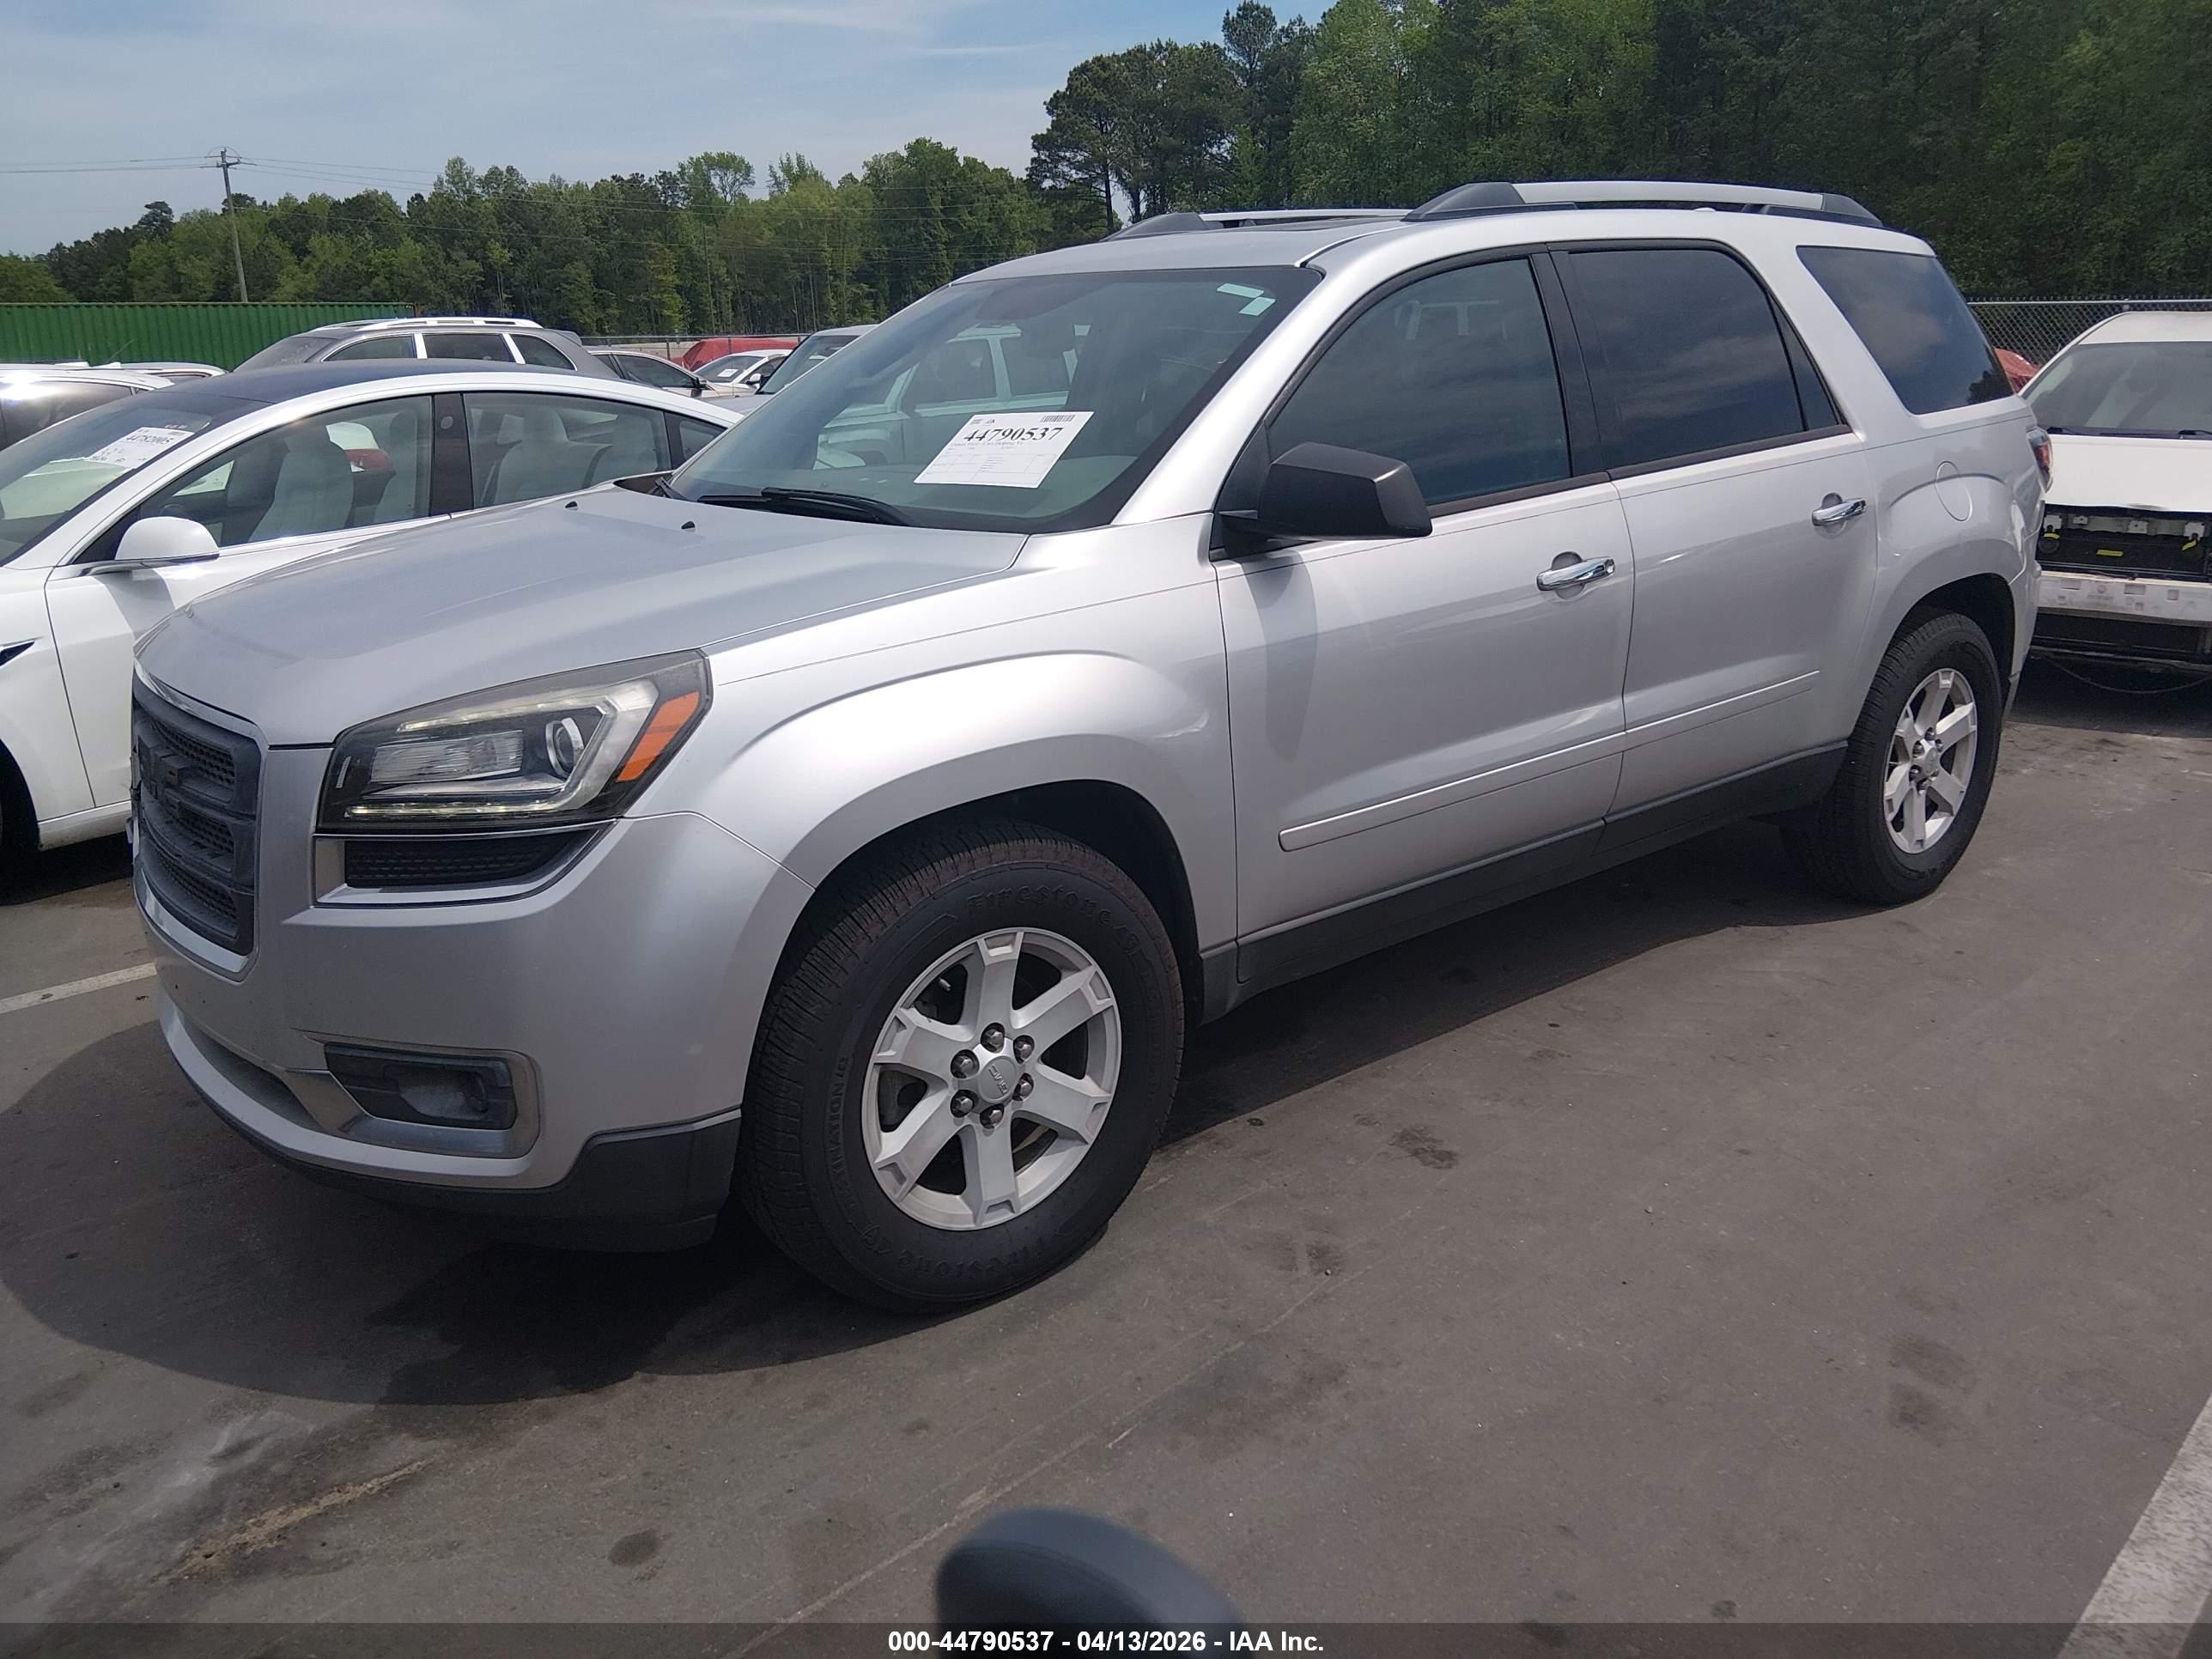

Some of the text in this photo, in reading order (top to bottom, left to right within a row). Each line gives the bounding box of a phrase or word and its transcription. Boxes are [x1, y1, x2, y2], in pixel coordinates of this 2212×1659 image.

[963, 427, 1064, 442] 44790537
[967, 884, 1114, 928] Firestone
[988, 1064, 1010, 1096] GMC
